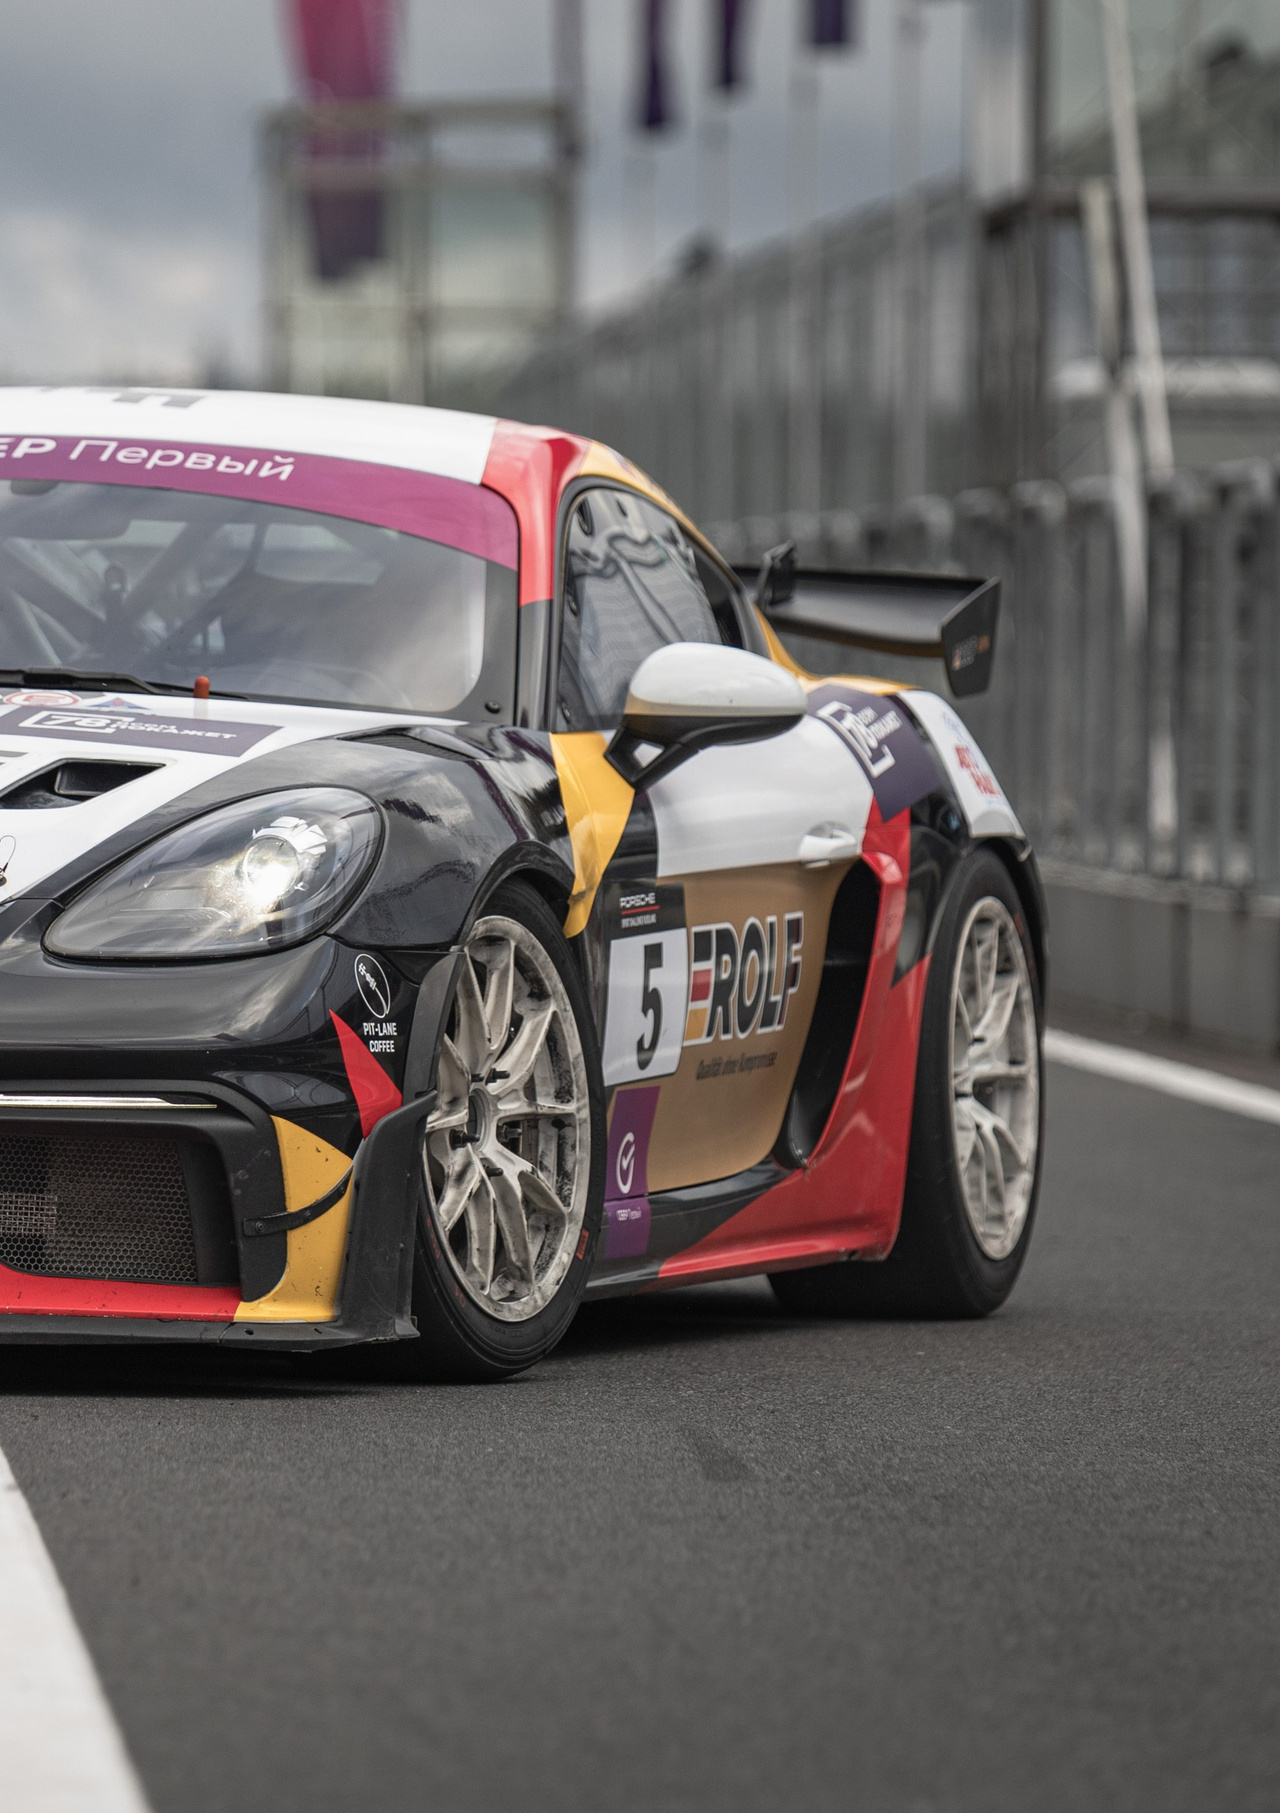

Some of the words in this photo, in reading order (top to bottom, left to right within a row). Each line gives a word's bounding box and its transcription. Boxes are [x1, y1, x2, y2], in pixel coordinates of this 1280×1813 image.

[69, 439, 296, 481] Первый
[42, 715, 112, 728] 78
[620, 892, 656, 908] PORSCHE
[704, 911, 805, 1042] ROLF
[637, 942, 664, 1071] 5
[363, 1022, 398, 1036] PIT-LANE
[369, 1040, 396, 1053] COFFEE
